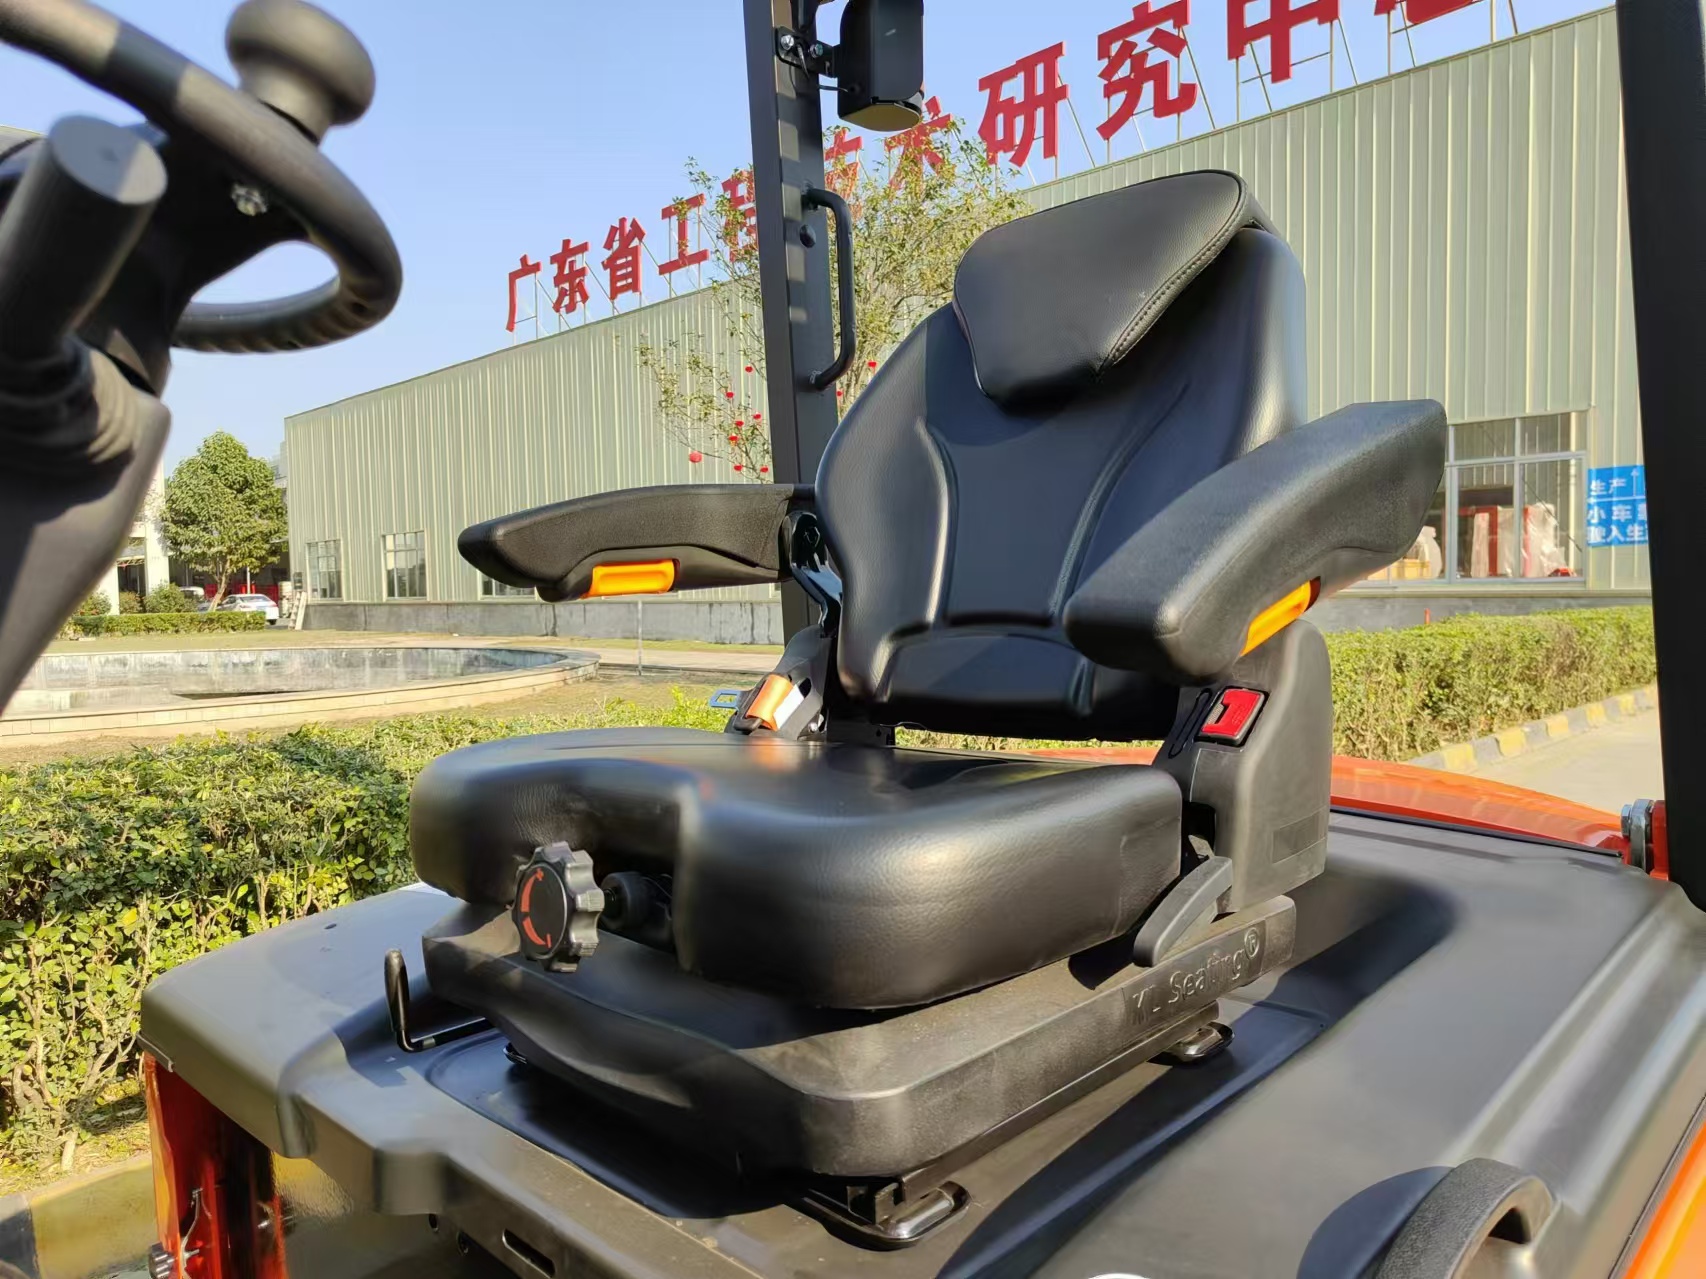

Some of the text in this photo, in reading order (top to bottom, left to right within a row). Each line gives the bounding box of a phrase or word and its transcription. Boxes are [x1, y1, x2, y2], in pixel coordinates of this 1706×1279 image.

[1590, 478, 1627, 496] 生产
[1587, 523, 1648, 544] 驶入生
